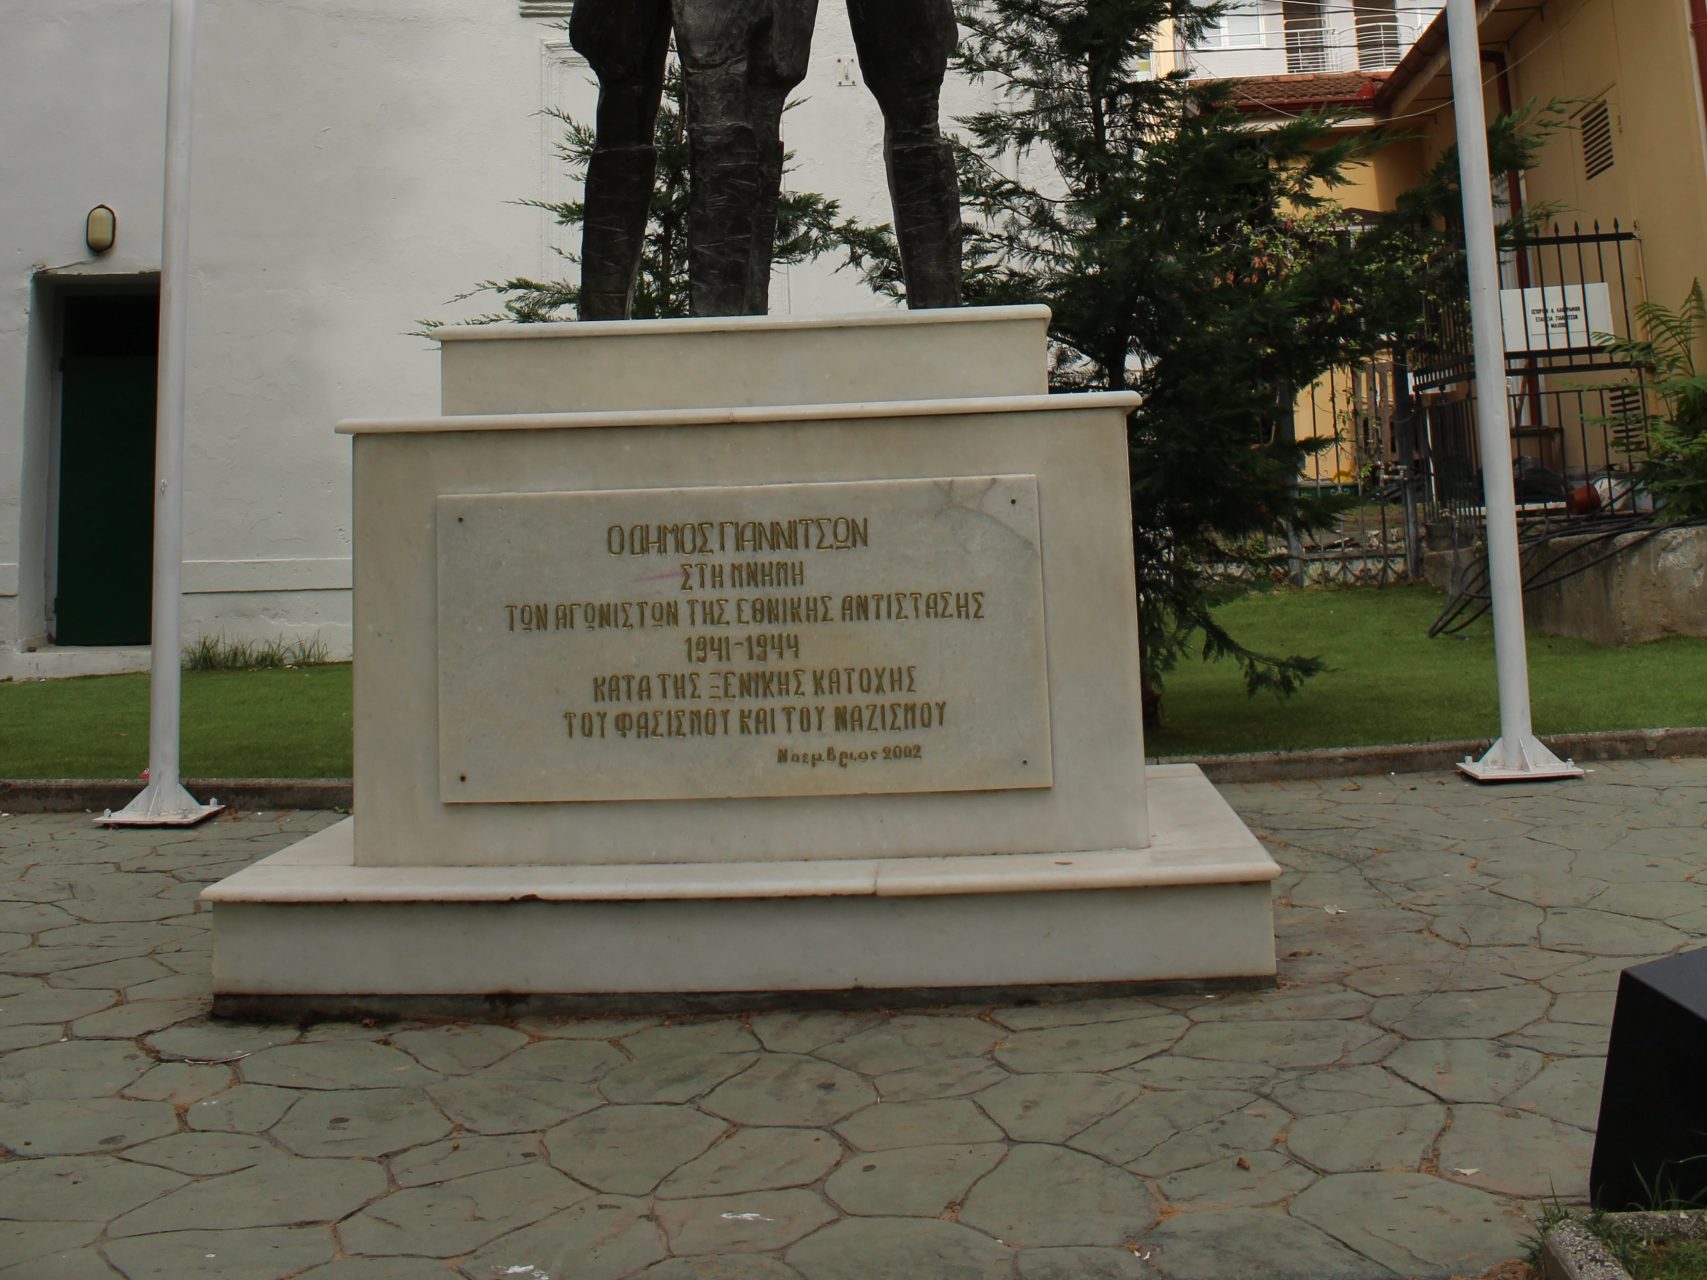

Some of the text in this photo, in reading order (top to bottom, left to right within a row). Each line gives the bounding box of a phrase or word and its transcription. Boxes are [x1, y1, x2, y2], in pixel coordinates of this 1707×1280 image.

[607, 517, 868, 557] Ο ΔΗΜΟΣ ΓΙΑΝΝΙΤΣΩΝ
[680, 561, 804, 592] ΣΤΗ ΜΝΗΜΗ
[505, 591, 985, 632] ΤΩΝ ΑΓΩΝΙΣΤΩΝ ΤΗΣ ΕΘΝΙΚΗΣ ΑΝΤΙΣΤΑΣΗΣ
[685, 632, 800, 664] 1941-1944
[592, 665, 917, 703] ΚΑΤΑ ΤΗΣ ΞΕΝΙΚΗΣ ΚΑΤΟΧΗΣ
[563, 700, 947, 739] ΤΟΥ ΦΑΣΙΣΜΟΥ ΚΑΙ ΤΟΥ ΝΑΖΙΣΜΟΥ
[882, 743, 923, 762] 2002
